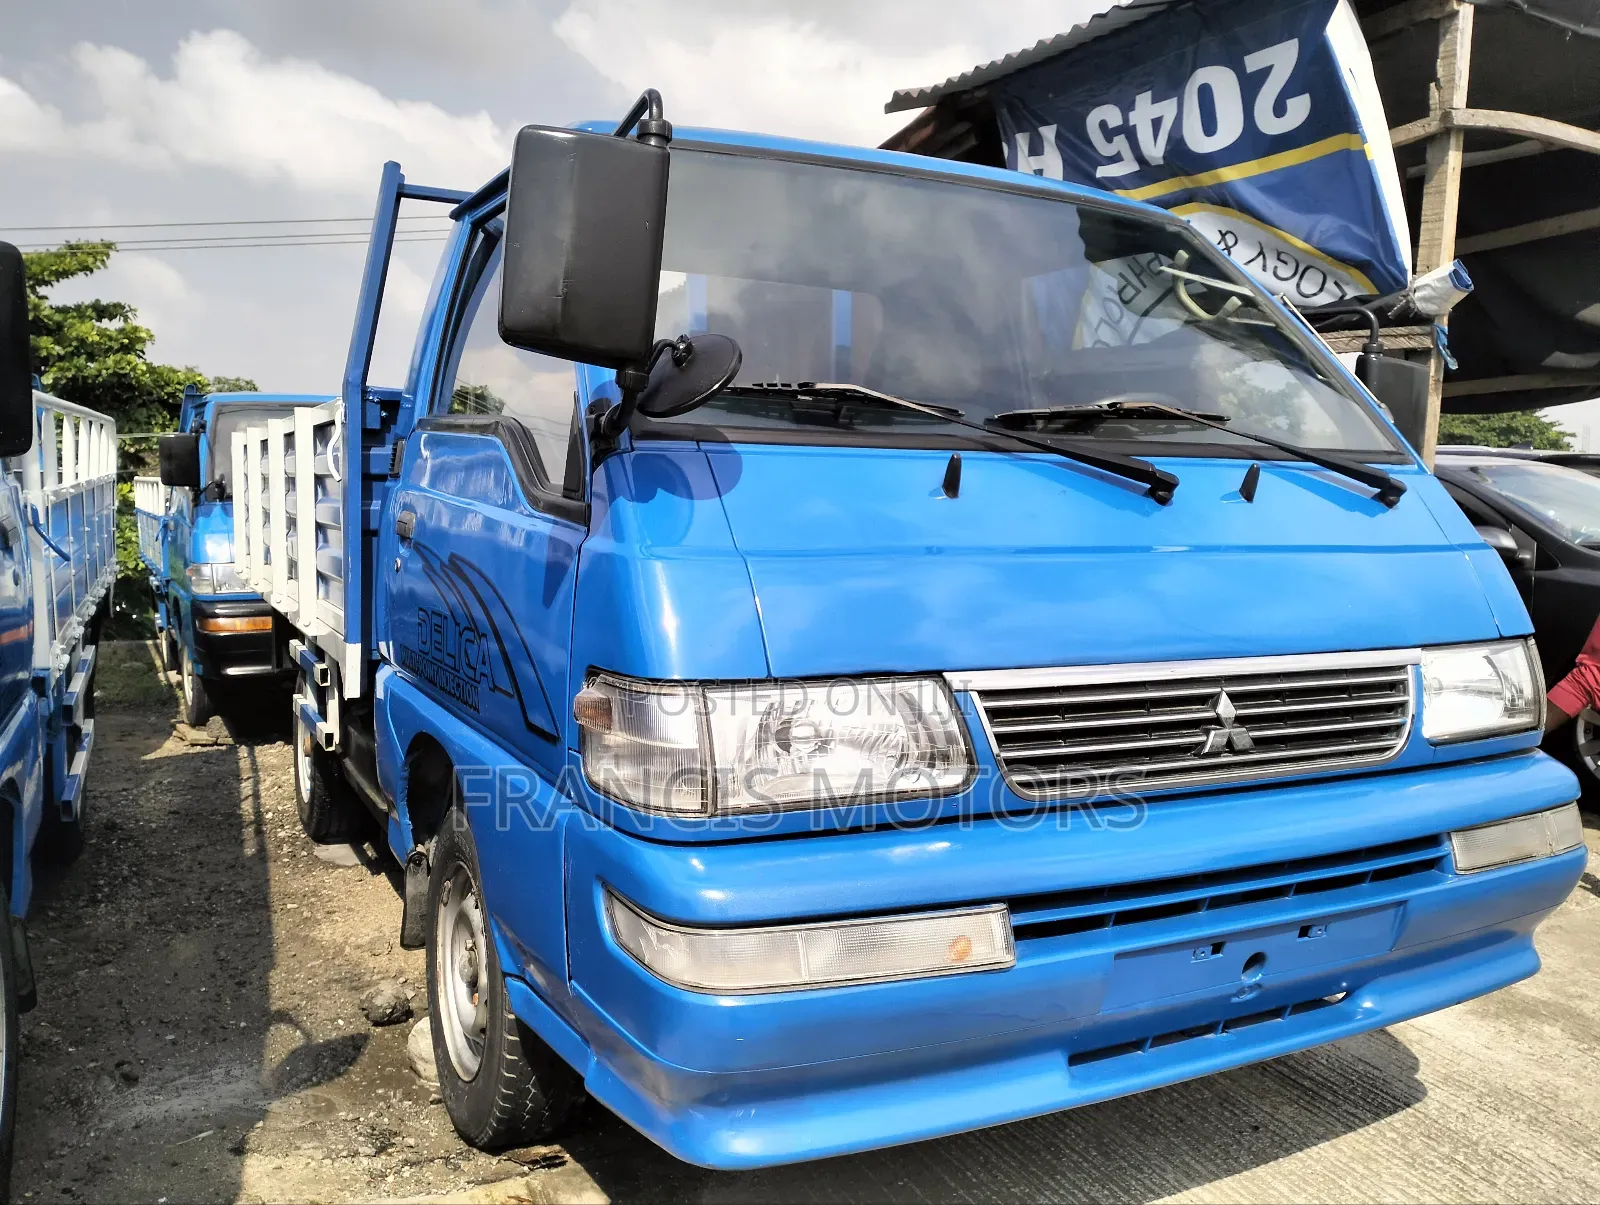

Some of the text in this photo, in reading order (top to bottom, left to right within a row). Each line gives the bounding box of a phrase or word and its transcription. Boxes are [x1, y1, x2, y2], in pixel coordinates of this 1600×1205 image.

[1086, 37, 1311, 178] 2045
[1217, 229, 1239, 257] &
[418, 607, 496, 693] DELICA
[440, 668, 480, 714] INJECTION
